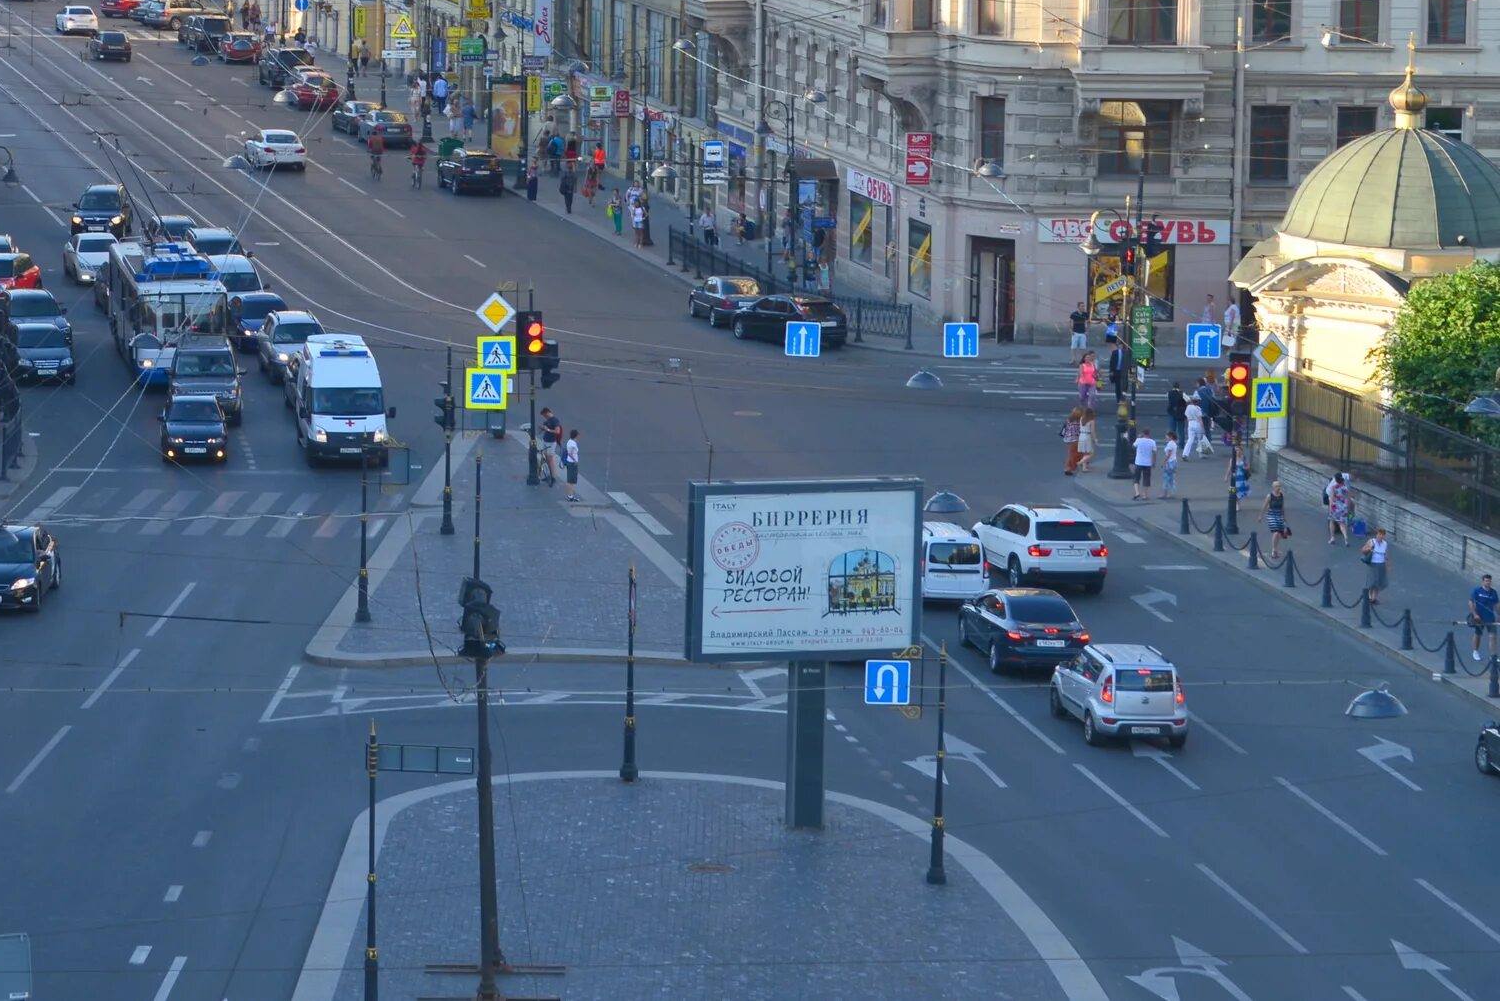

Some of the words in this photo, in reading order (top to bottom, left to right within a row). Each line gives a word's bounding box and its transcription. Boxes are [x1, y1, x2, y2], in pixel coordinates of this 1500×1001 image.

[535, 6, 551, 44] Solvex
[616, 100, 628, 108] 24
[866, 177, 892, 205] ОБУВЬ
[712, 503, 737, 511] ITALY
[752, 509, 869, 527] БИРРЕРИЯ
[717, 539, 753, 555] ОБЕДЫ
[725, 566, 803, 587] ВИДОВОЙ
[723, 586, 810, 603] РЕСТОРАН!
[710, 629, 774, 639] Владимирский
